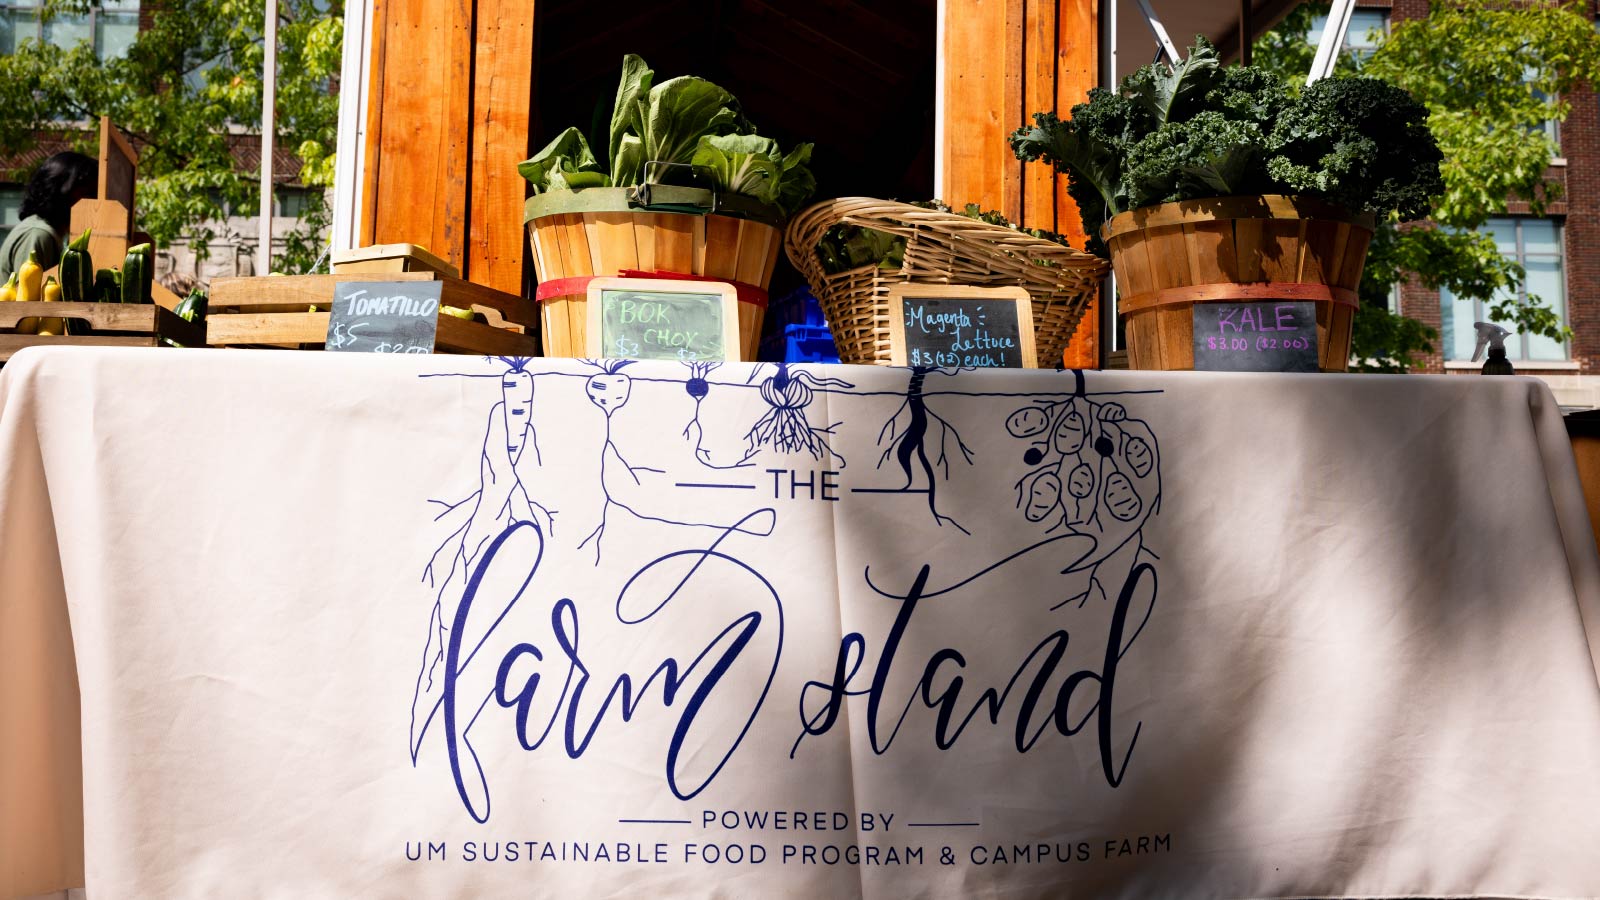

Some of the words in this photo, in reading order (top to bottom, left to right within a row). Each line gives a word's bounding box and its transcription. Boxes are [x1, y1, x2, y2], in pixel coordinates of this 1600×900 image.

[343, 289, 438, 317] TOMATILLO
[620, 299, 671, 325] BOK
[910, 304, 972, 334] Magenta
[1218, 305, 1298, 334] KALE
[331, 321, 370, 349] $5
[615, 334, 640, 358] $3
[643, 328, 699, 349] CHOY
[950, 327, 1015, 352] Lettuce
[1207, 335, 1248, 352] $3.00
[765, 469, 840, 501] THE
[410, 507, 784, 824] farm
[790, 533, 1158, 788] stand
[702, 810, 849, 831] POWERED
[860, 812, 895, 832] BY
[405, 841, 447, 862] UM
[462, 841, 668, 864] SUSTAINABLE
[684, 843, 767, 864] FOOD
[782, 844, 924, 866] PROGRAM
[939, 846, 956, 865] &
[970, 841, 1091, 866] CAMPUS
[1103, 832, 1172, 859] FARM
